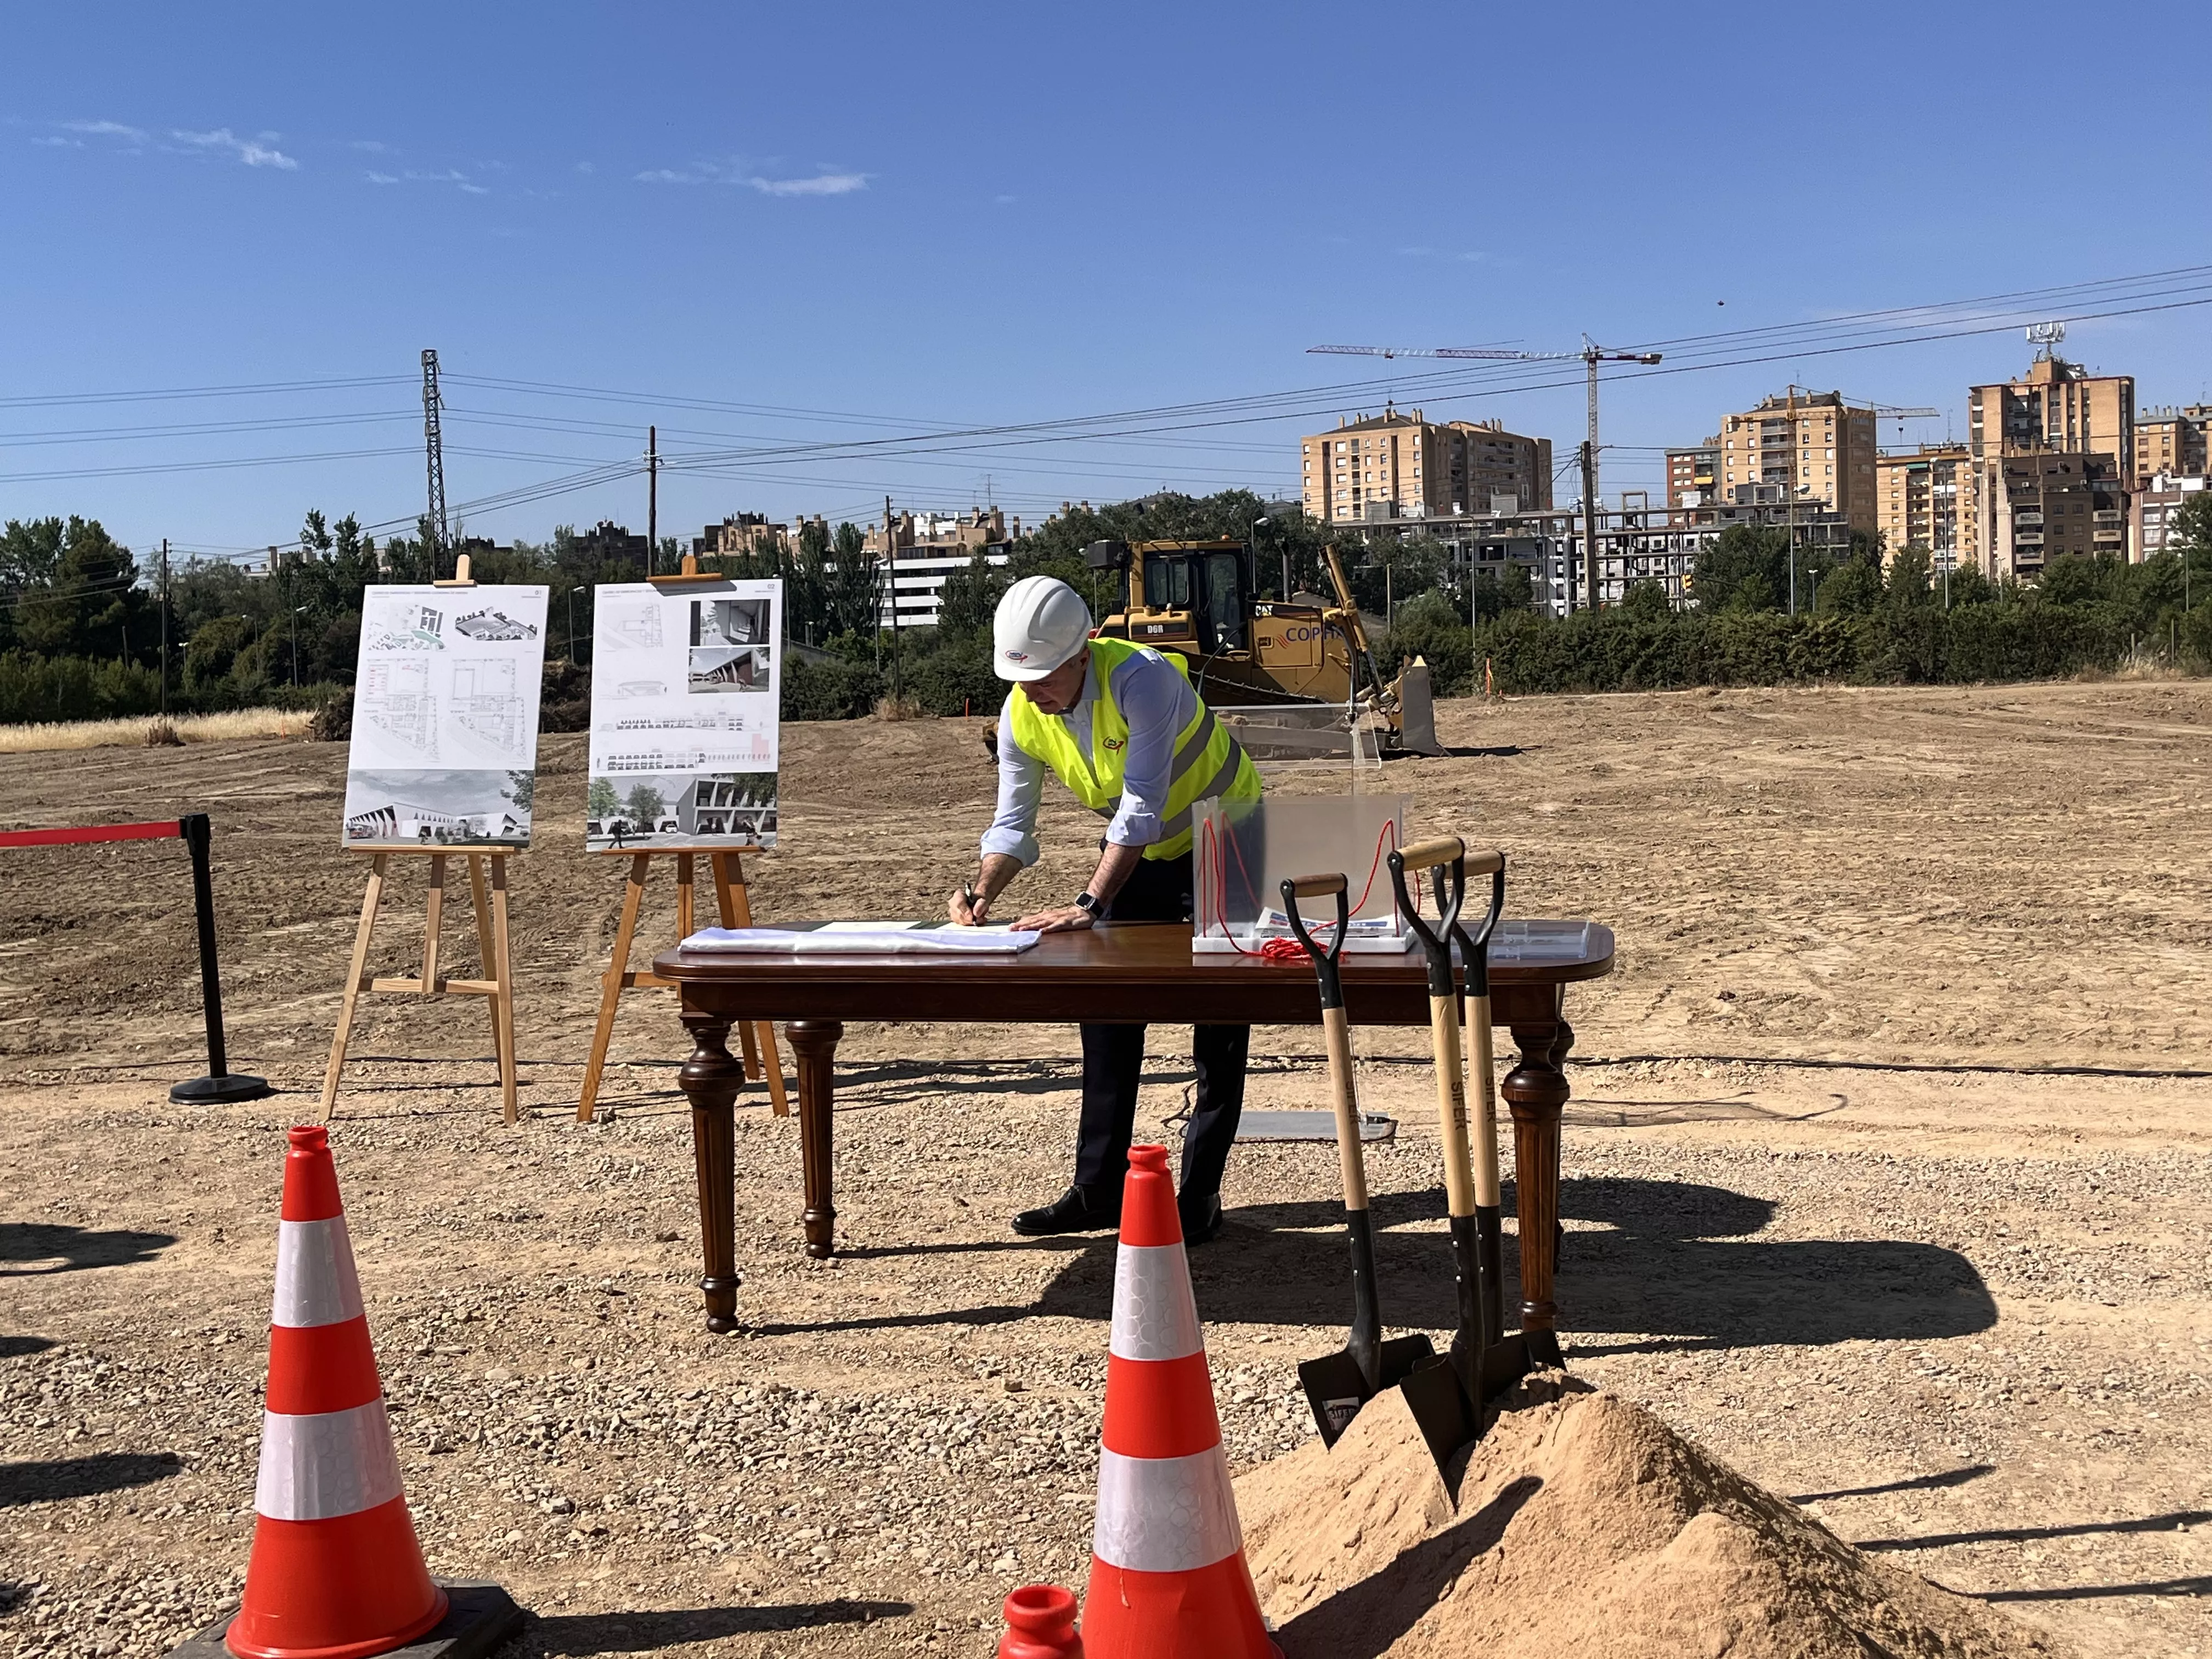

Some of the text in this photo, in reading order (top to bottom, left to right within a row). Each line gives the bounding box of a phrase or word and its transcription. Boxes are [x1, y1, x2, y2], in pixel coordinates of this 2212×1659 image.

[1255, 605, 1273, 617] CAT
[1147, 625, 1164, 634] D6R
[1451, 1081, 1466, 1130] SIFER
[1486, 1076, 1496, 1122] SIFER
